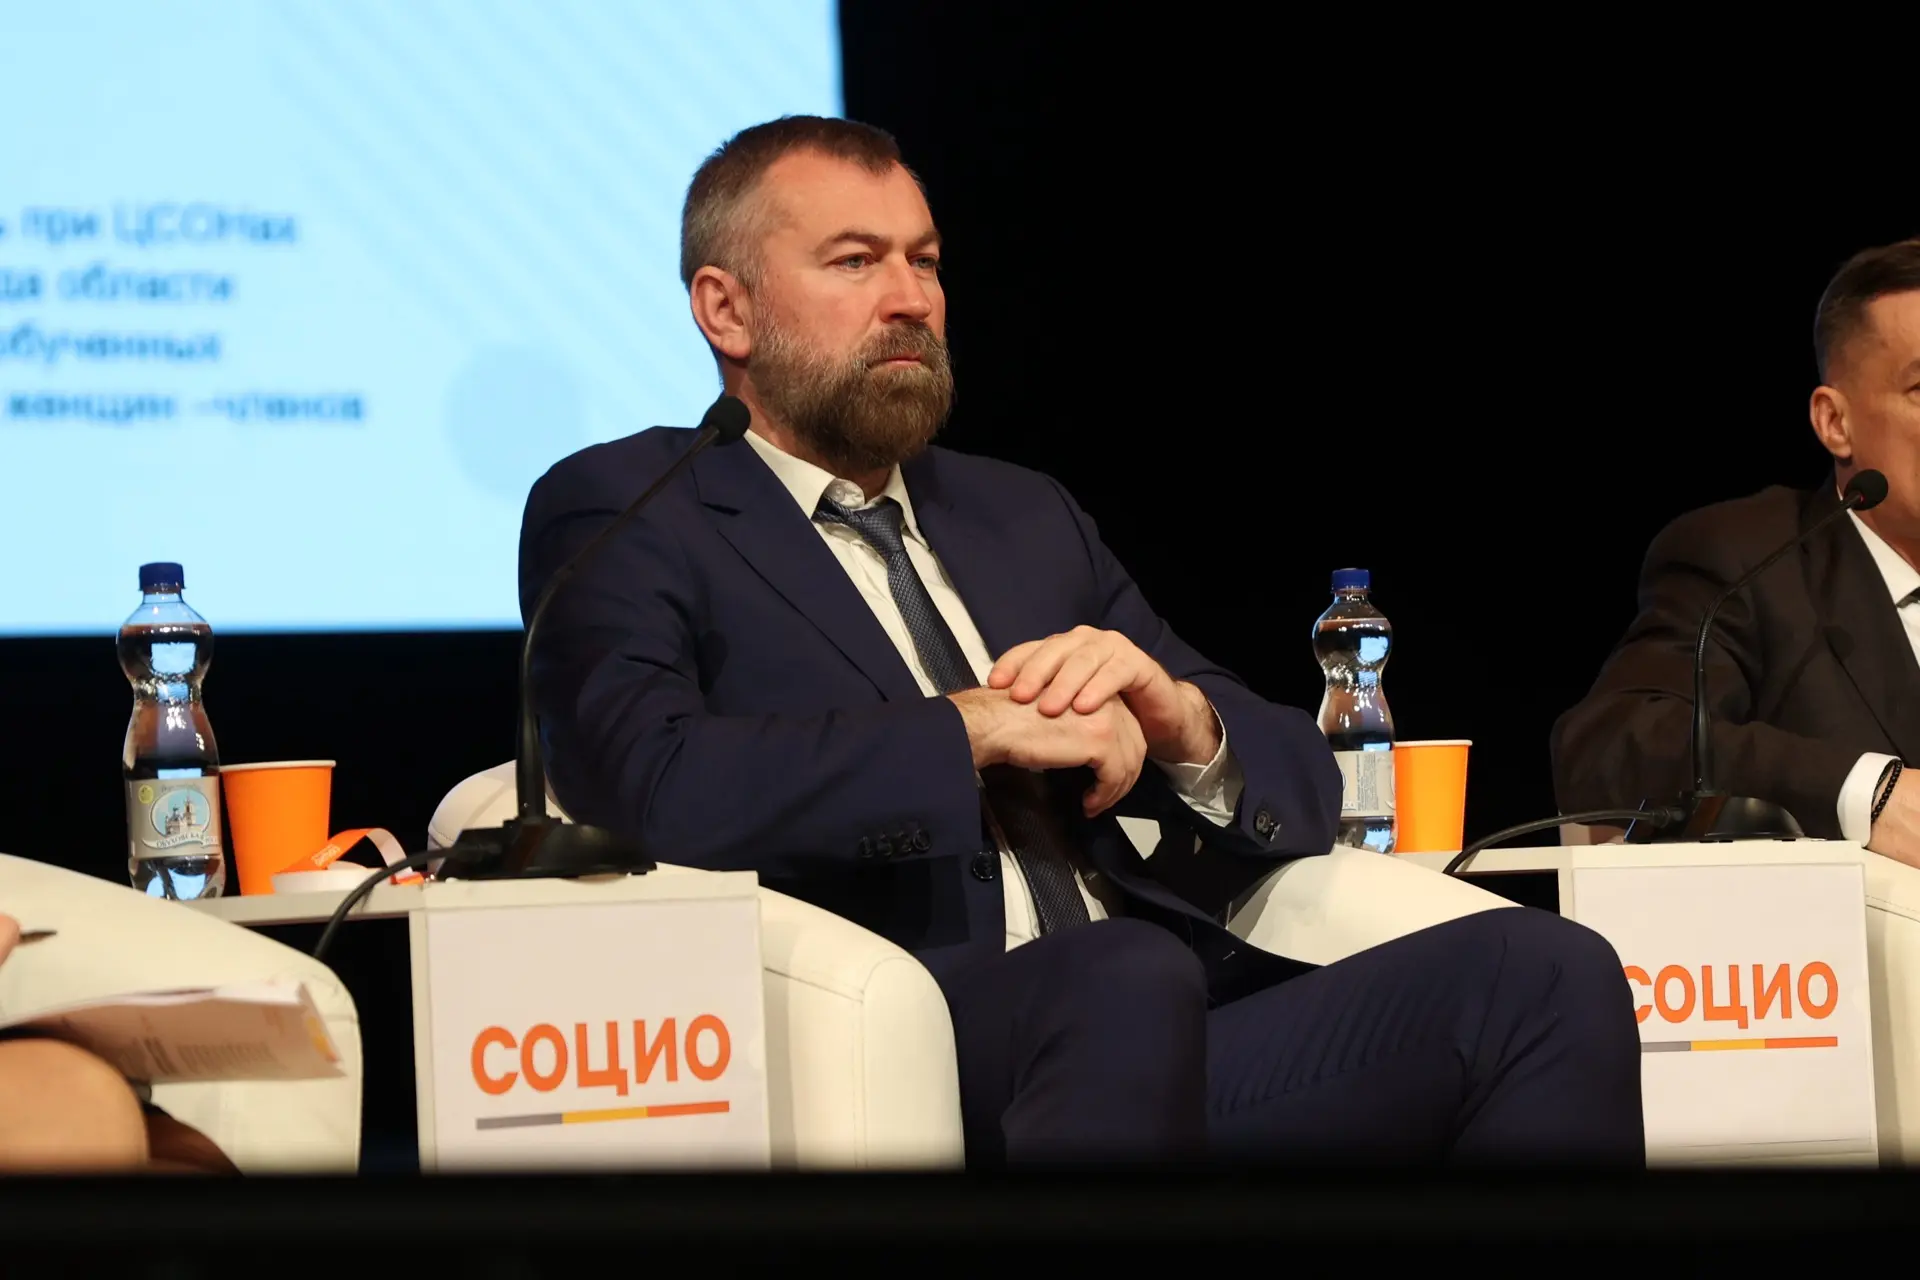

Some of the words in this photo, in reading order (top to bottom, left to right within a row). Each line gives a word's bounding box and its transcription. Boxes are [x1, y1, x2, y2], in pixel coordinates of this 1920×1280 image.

[22, 208, 100, 246] при
[58, 260, 235, 301] области
[8, 391, 177, 425] женщин
[471, 1014, 731, 1096] СОЦИО
